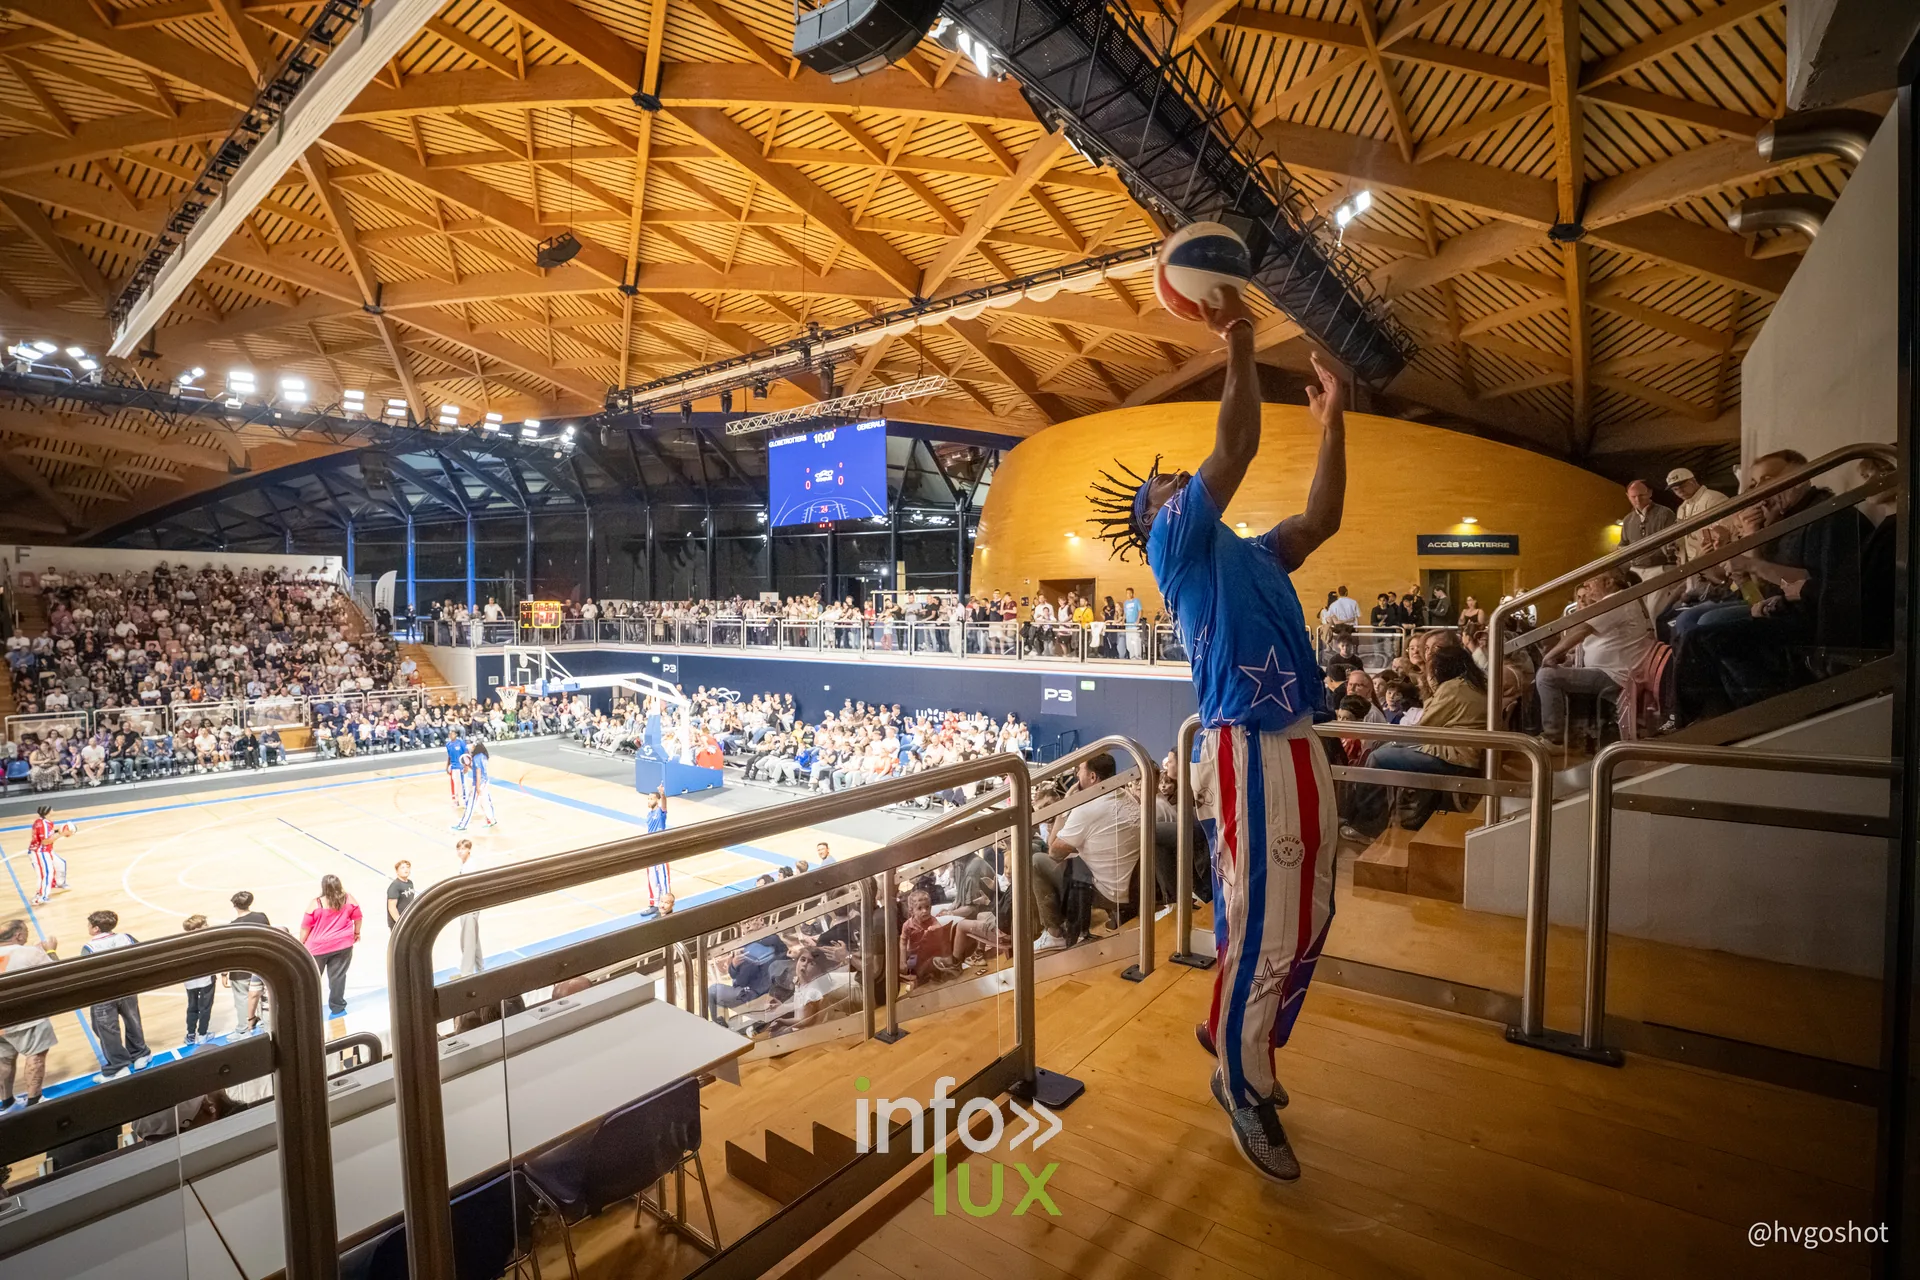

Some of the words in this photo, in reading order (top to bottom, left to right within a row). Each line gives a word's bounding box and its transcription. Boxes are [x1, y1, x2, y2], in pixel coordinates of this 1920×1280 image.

[813, 431, 835, 443] 10:00
[805, 480, 811, 490] 0
[838, 475, 844, 485] 0
[1461, 541, 1510, 549] PARTERRE
[15, 546, 32, 564] F
[662, 663, 677, 674] P3
[1044, 687, 1073, 702] P3
